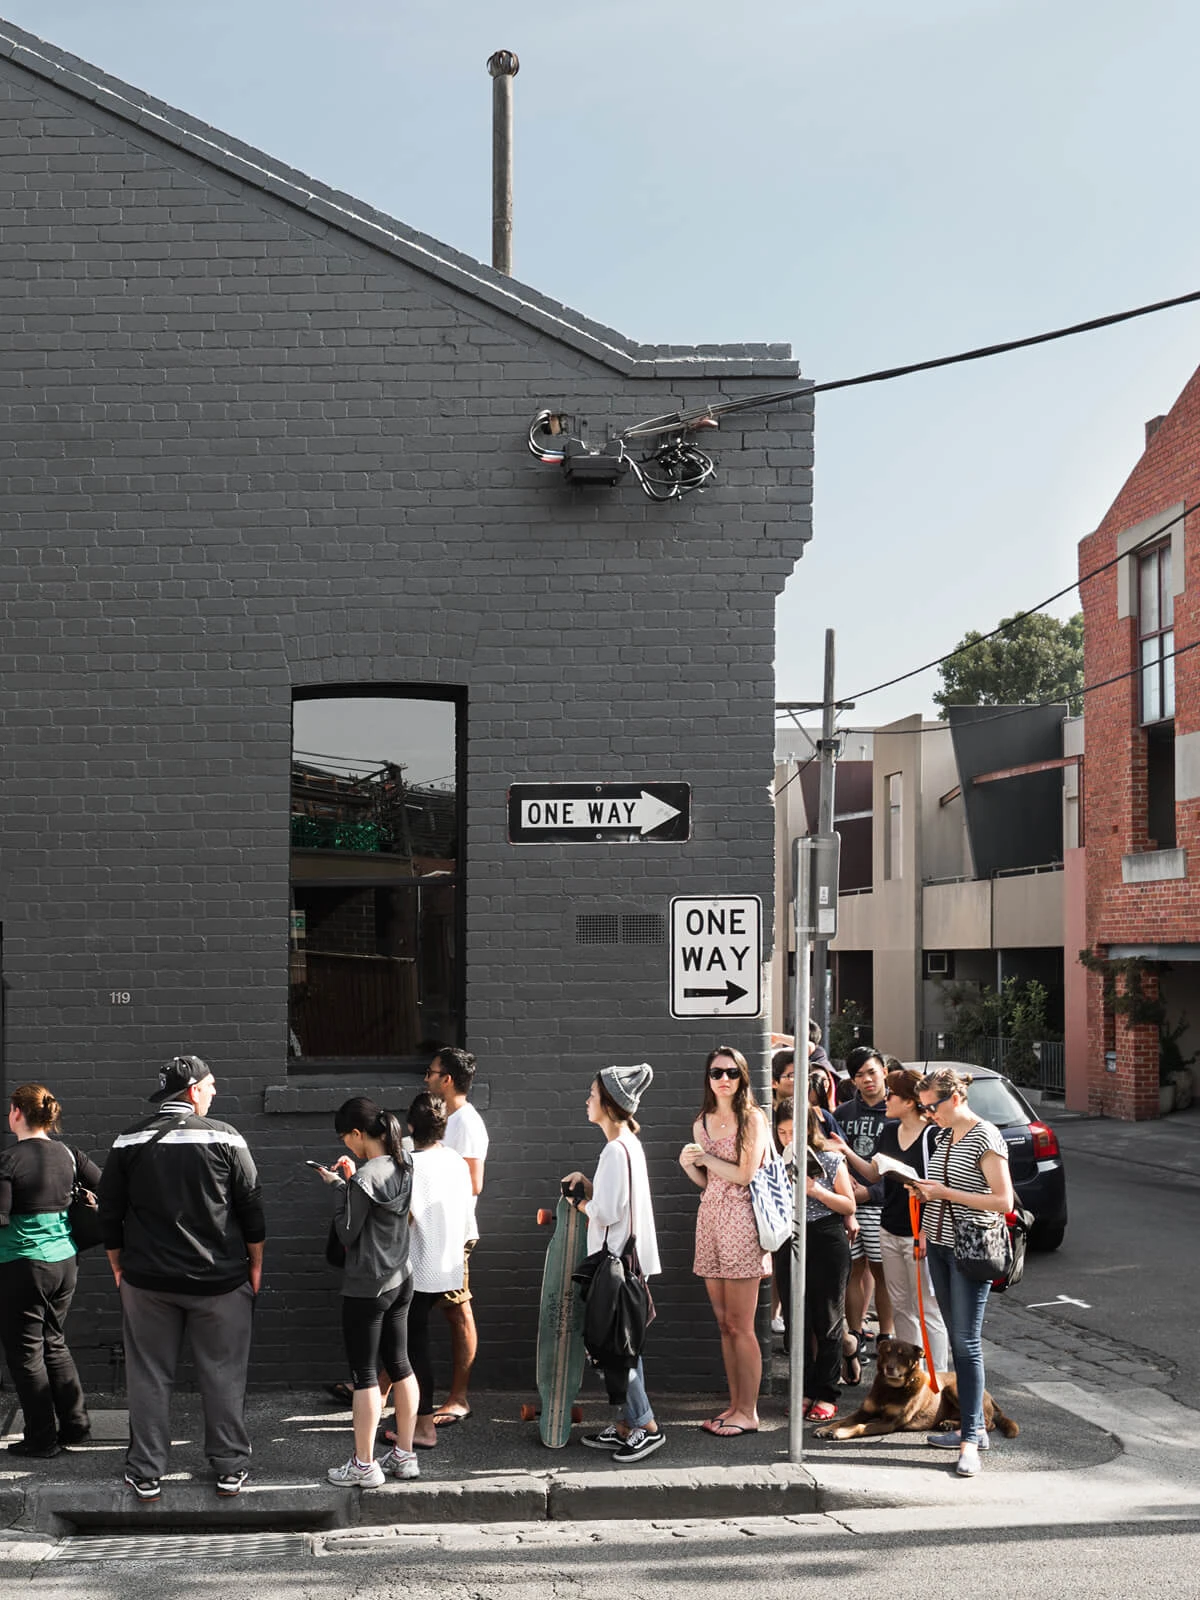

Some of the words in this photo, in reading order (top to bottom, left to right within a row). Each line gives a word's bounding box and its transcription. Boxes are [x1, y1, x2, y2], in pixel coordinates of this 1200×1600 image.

[527, 803, 574, 824] ONE
[588, 802, 636, 824] WAY
[686, 909, 746, 935] ONE
[681, 946, 750, 971] WAY
[109, 991, 131, 1004] 119
